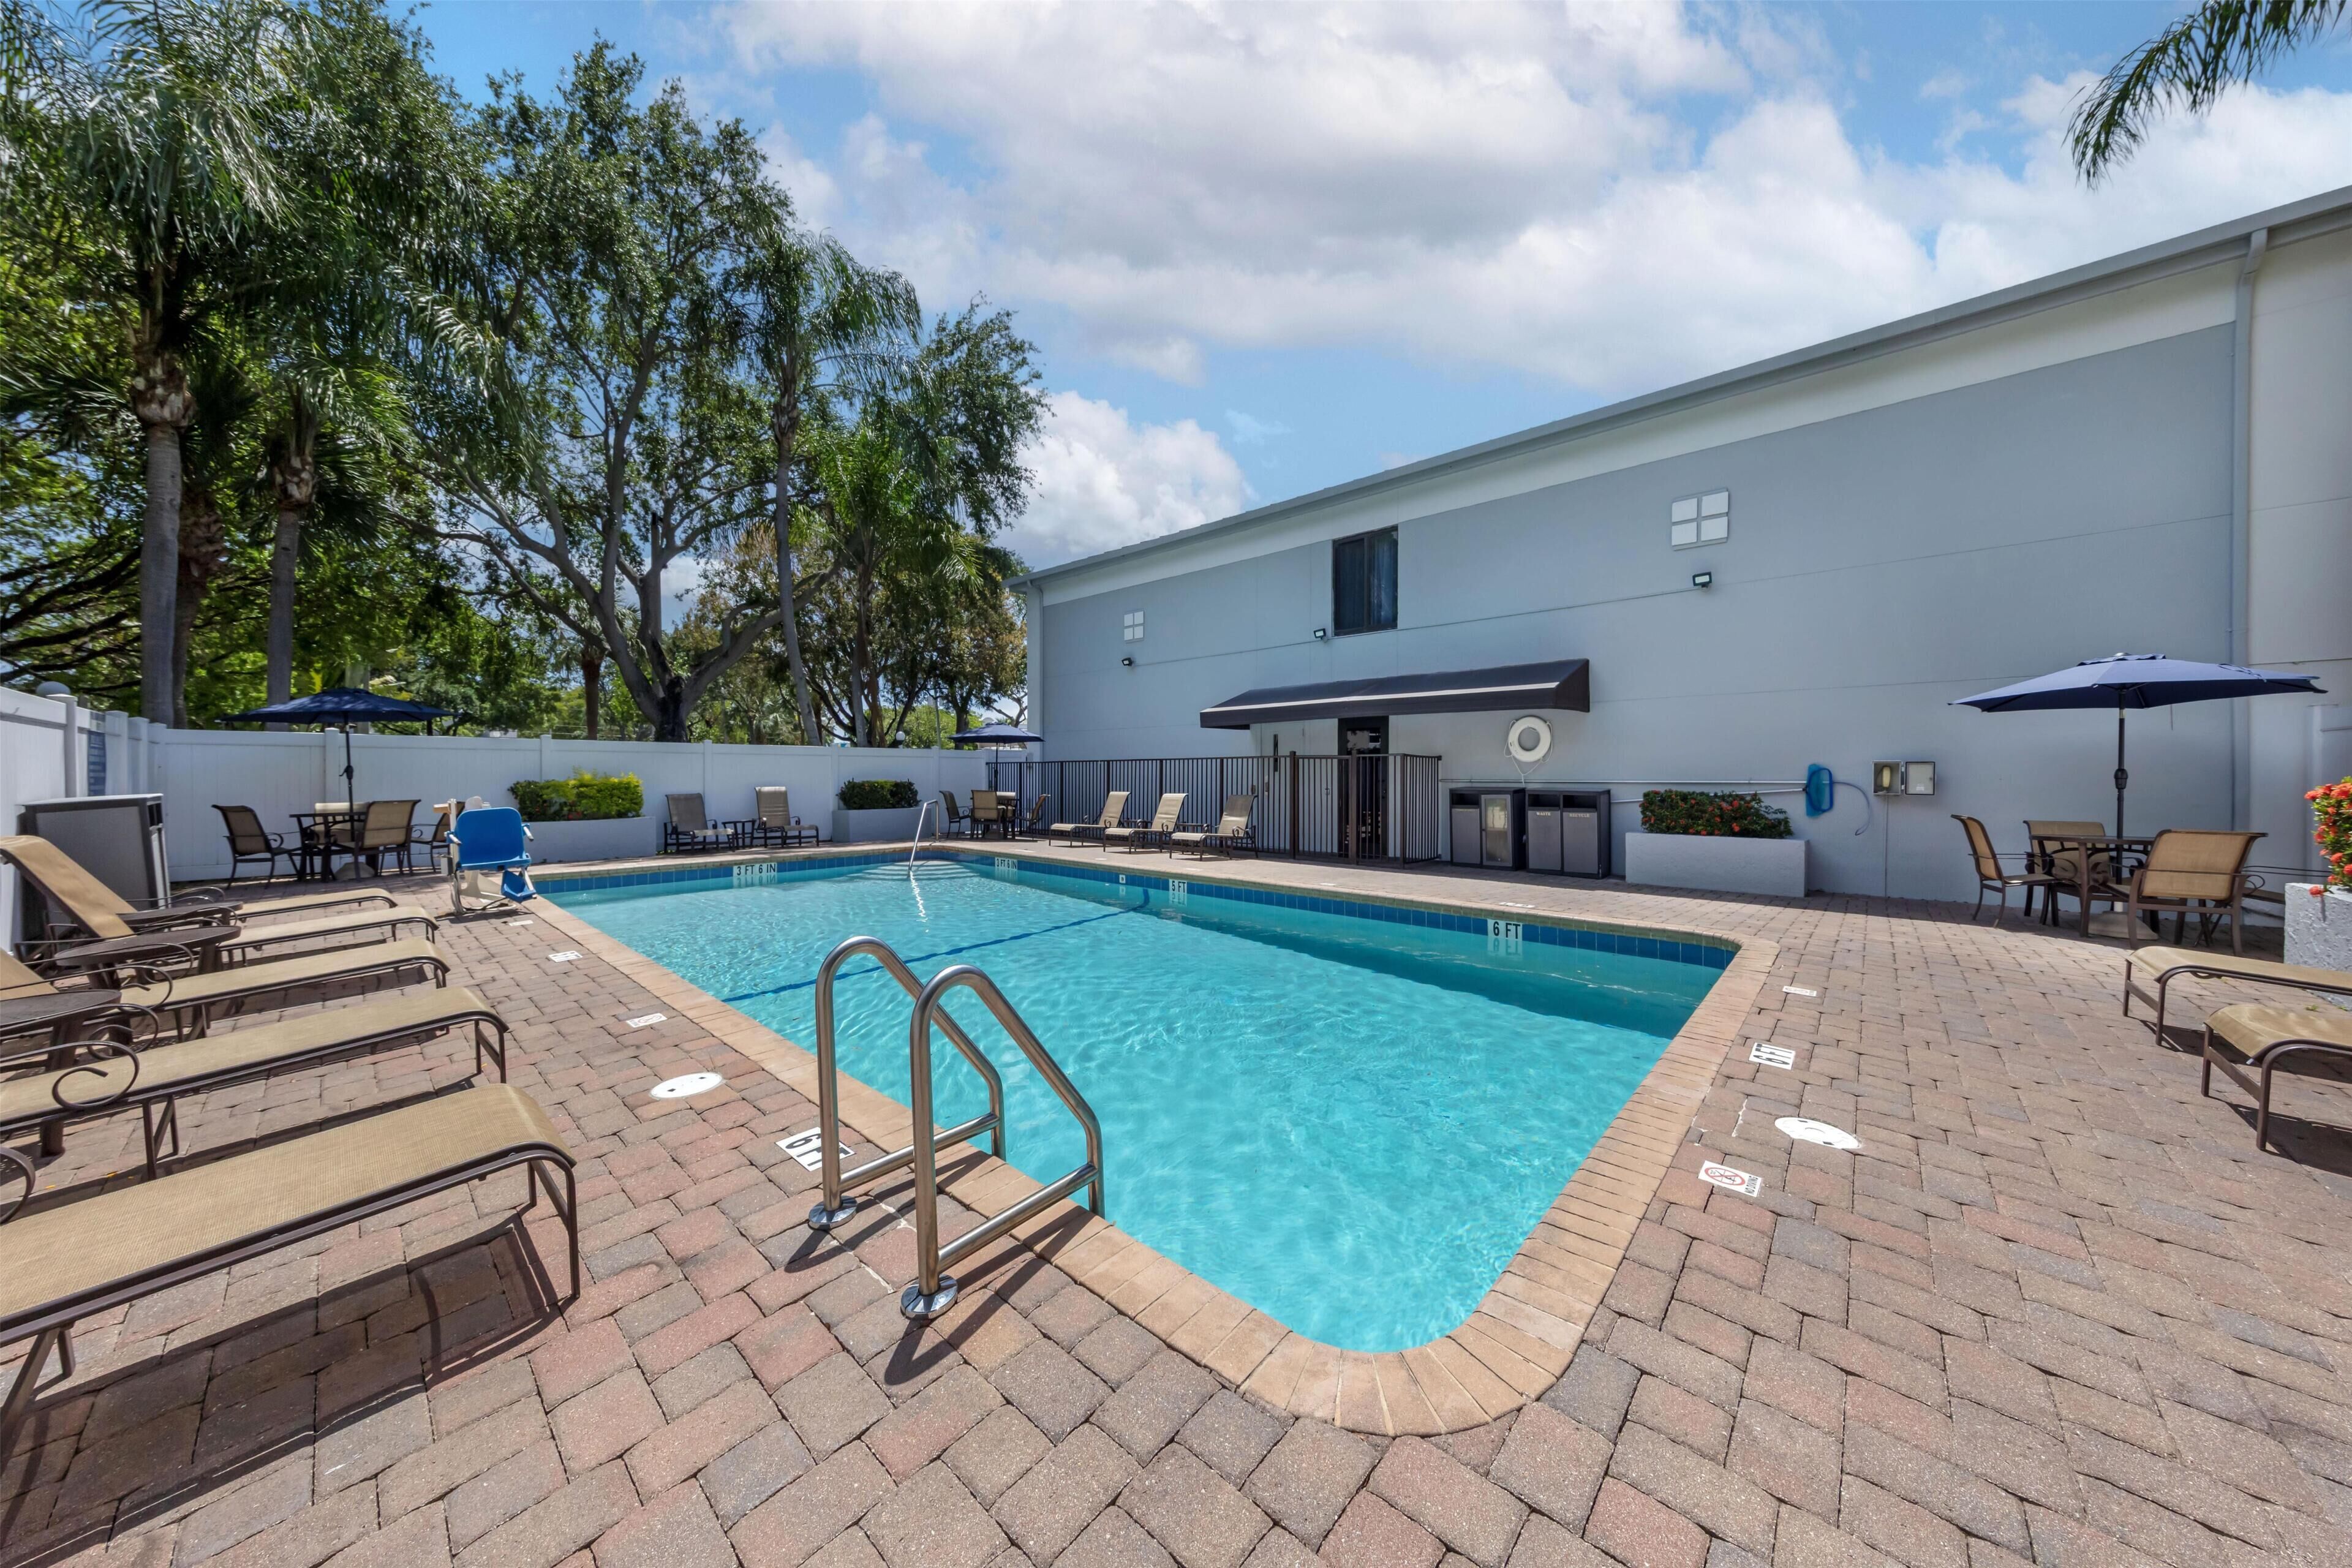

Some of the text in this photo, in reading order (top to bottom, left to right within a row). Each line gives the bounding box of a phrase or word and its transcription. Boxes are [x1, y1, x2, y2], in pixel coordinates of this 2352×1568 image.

[737, 863, 776, 875] 3 FT 6 IN
[1007, 859, 1010, 869] 6
[1011, 860, 1017, 869] IN
[1172, 880, 1186, 892] 5 FT
[1493, 921, 1520, 939] 6 FT
[1753, 1044, 1793, 1065] 6 FT
[1746, 1175, 1759, 1189] DIVING
